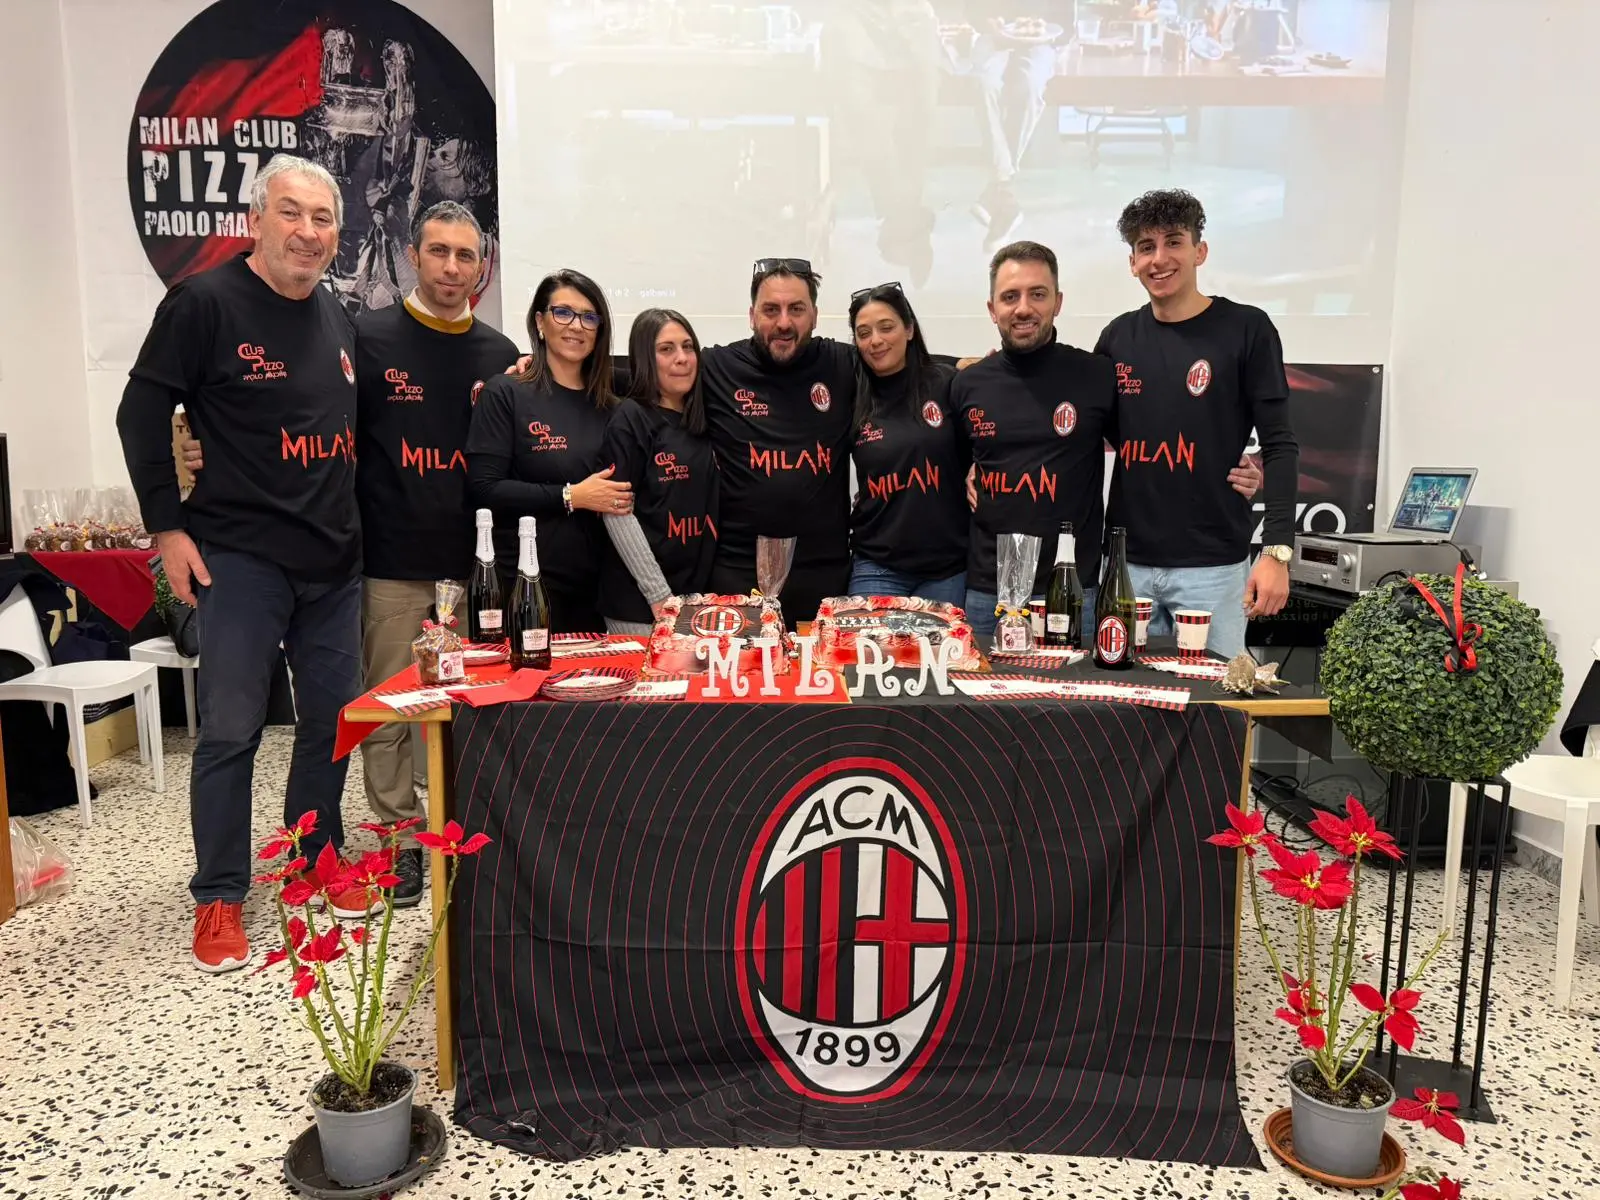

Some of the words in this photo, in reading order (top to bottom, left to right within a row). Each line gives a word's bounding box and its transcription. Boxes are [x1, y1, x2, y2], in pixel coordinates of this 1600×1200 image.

[139, 116, 219, 146] MILAN
[233, 119, 298, 149] CLUB
[142, 150, 259, 204] PIZZ
[144, 210, 211, 237] PAOLO
[215, 211, 250, 238] MA
[401, 436, 468, 477] MILA
[749, 439, 832, 478] MILAN
[867, 456, 940, 503] MILAN
[979, 463, 1057, 503] MILAN
[668, 510, 718, 545] MILA
[787, 785, 920, 857] ACM
[794, 1027, 901, 1068] 1899
